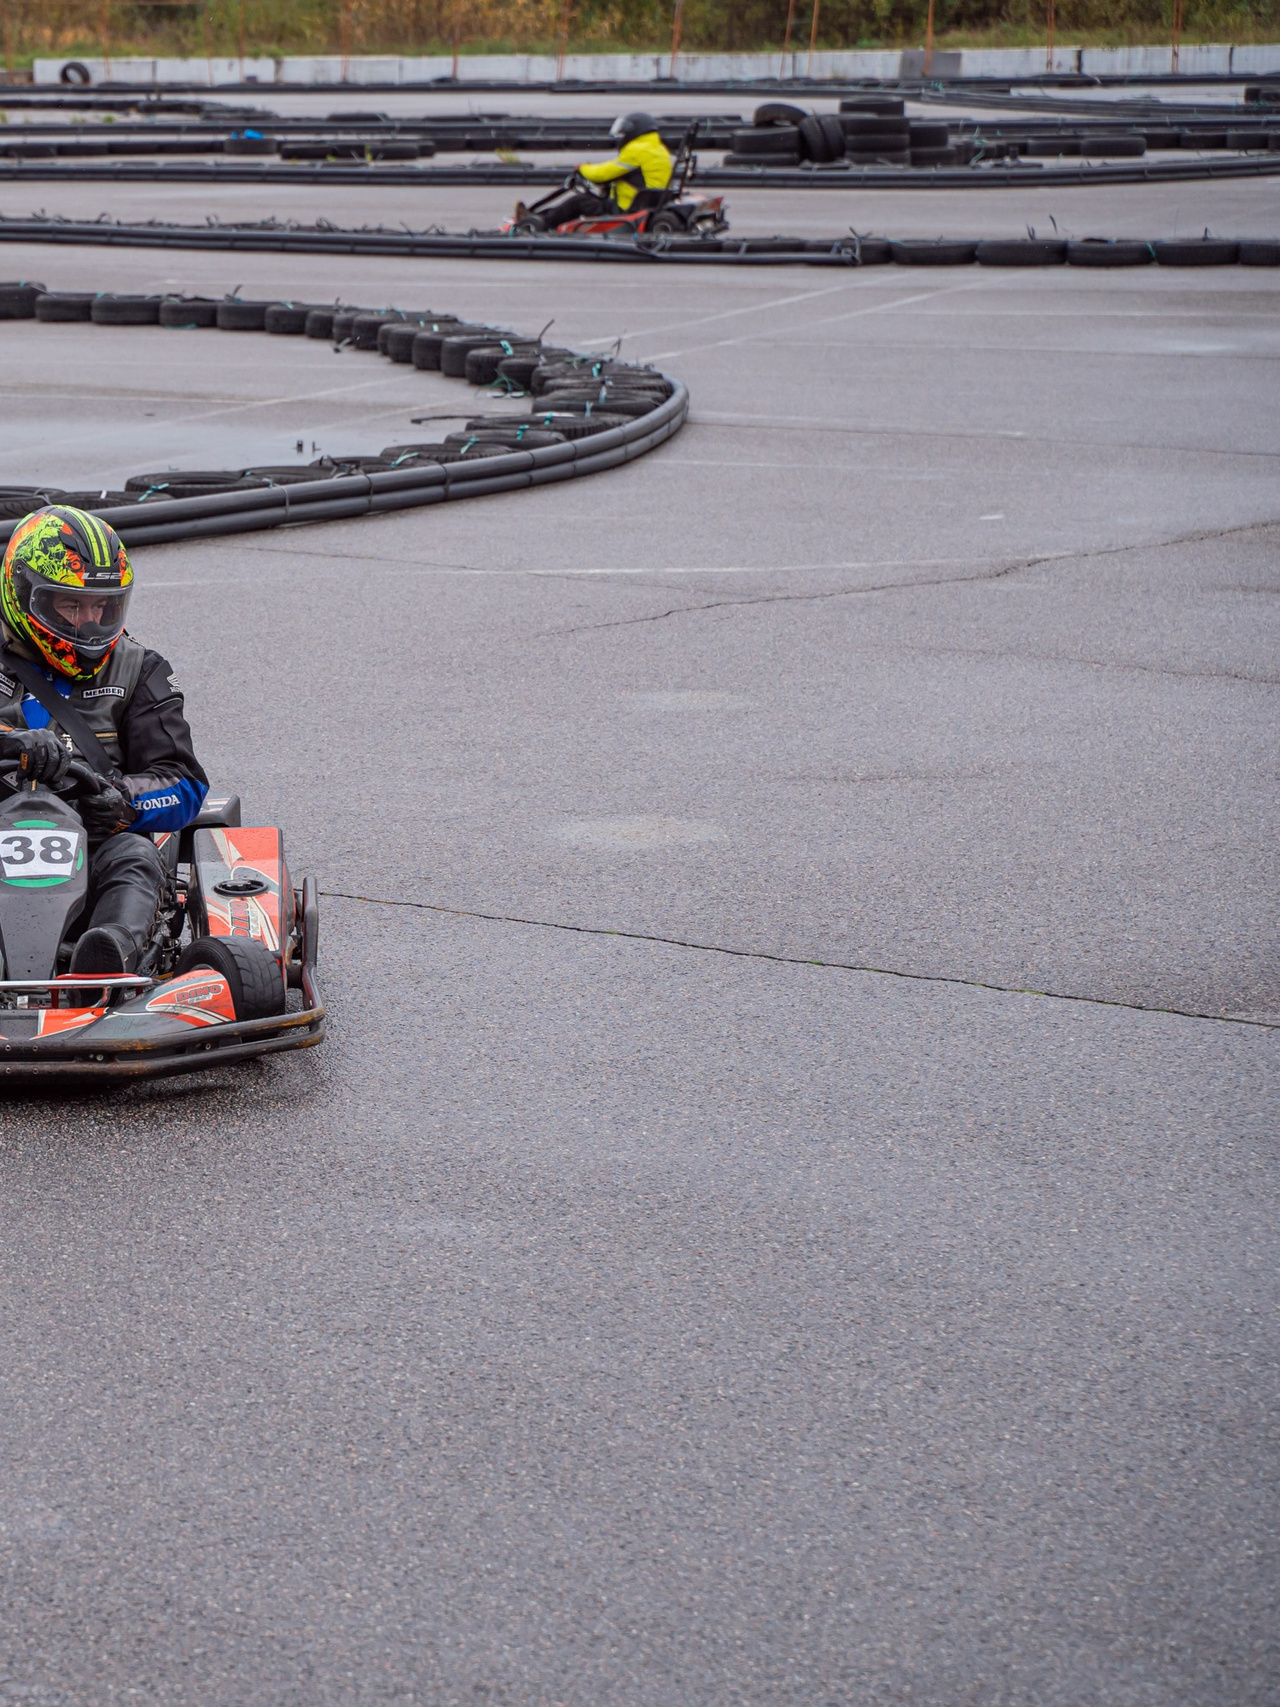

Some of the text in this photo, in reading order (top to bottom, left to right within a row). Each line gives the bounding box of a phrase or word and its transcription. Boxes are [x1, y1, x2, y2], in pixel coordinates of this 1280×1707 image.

[81, 572, 122, 580] LS2
[84, 686, 123, 697] MEMBER
[1, 836, 74, 865] 38
[176, 985, 222, 1002] DINO
